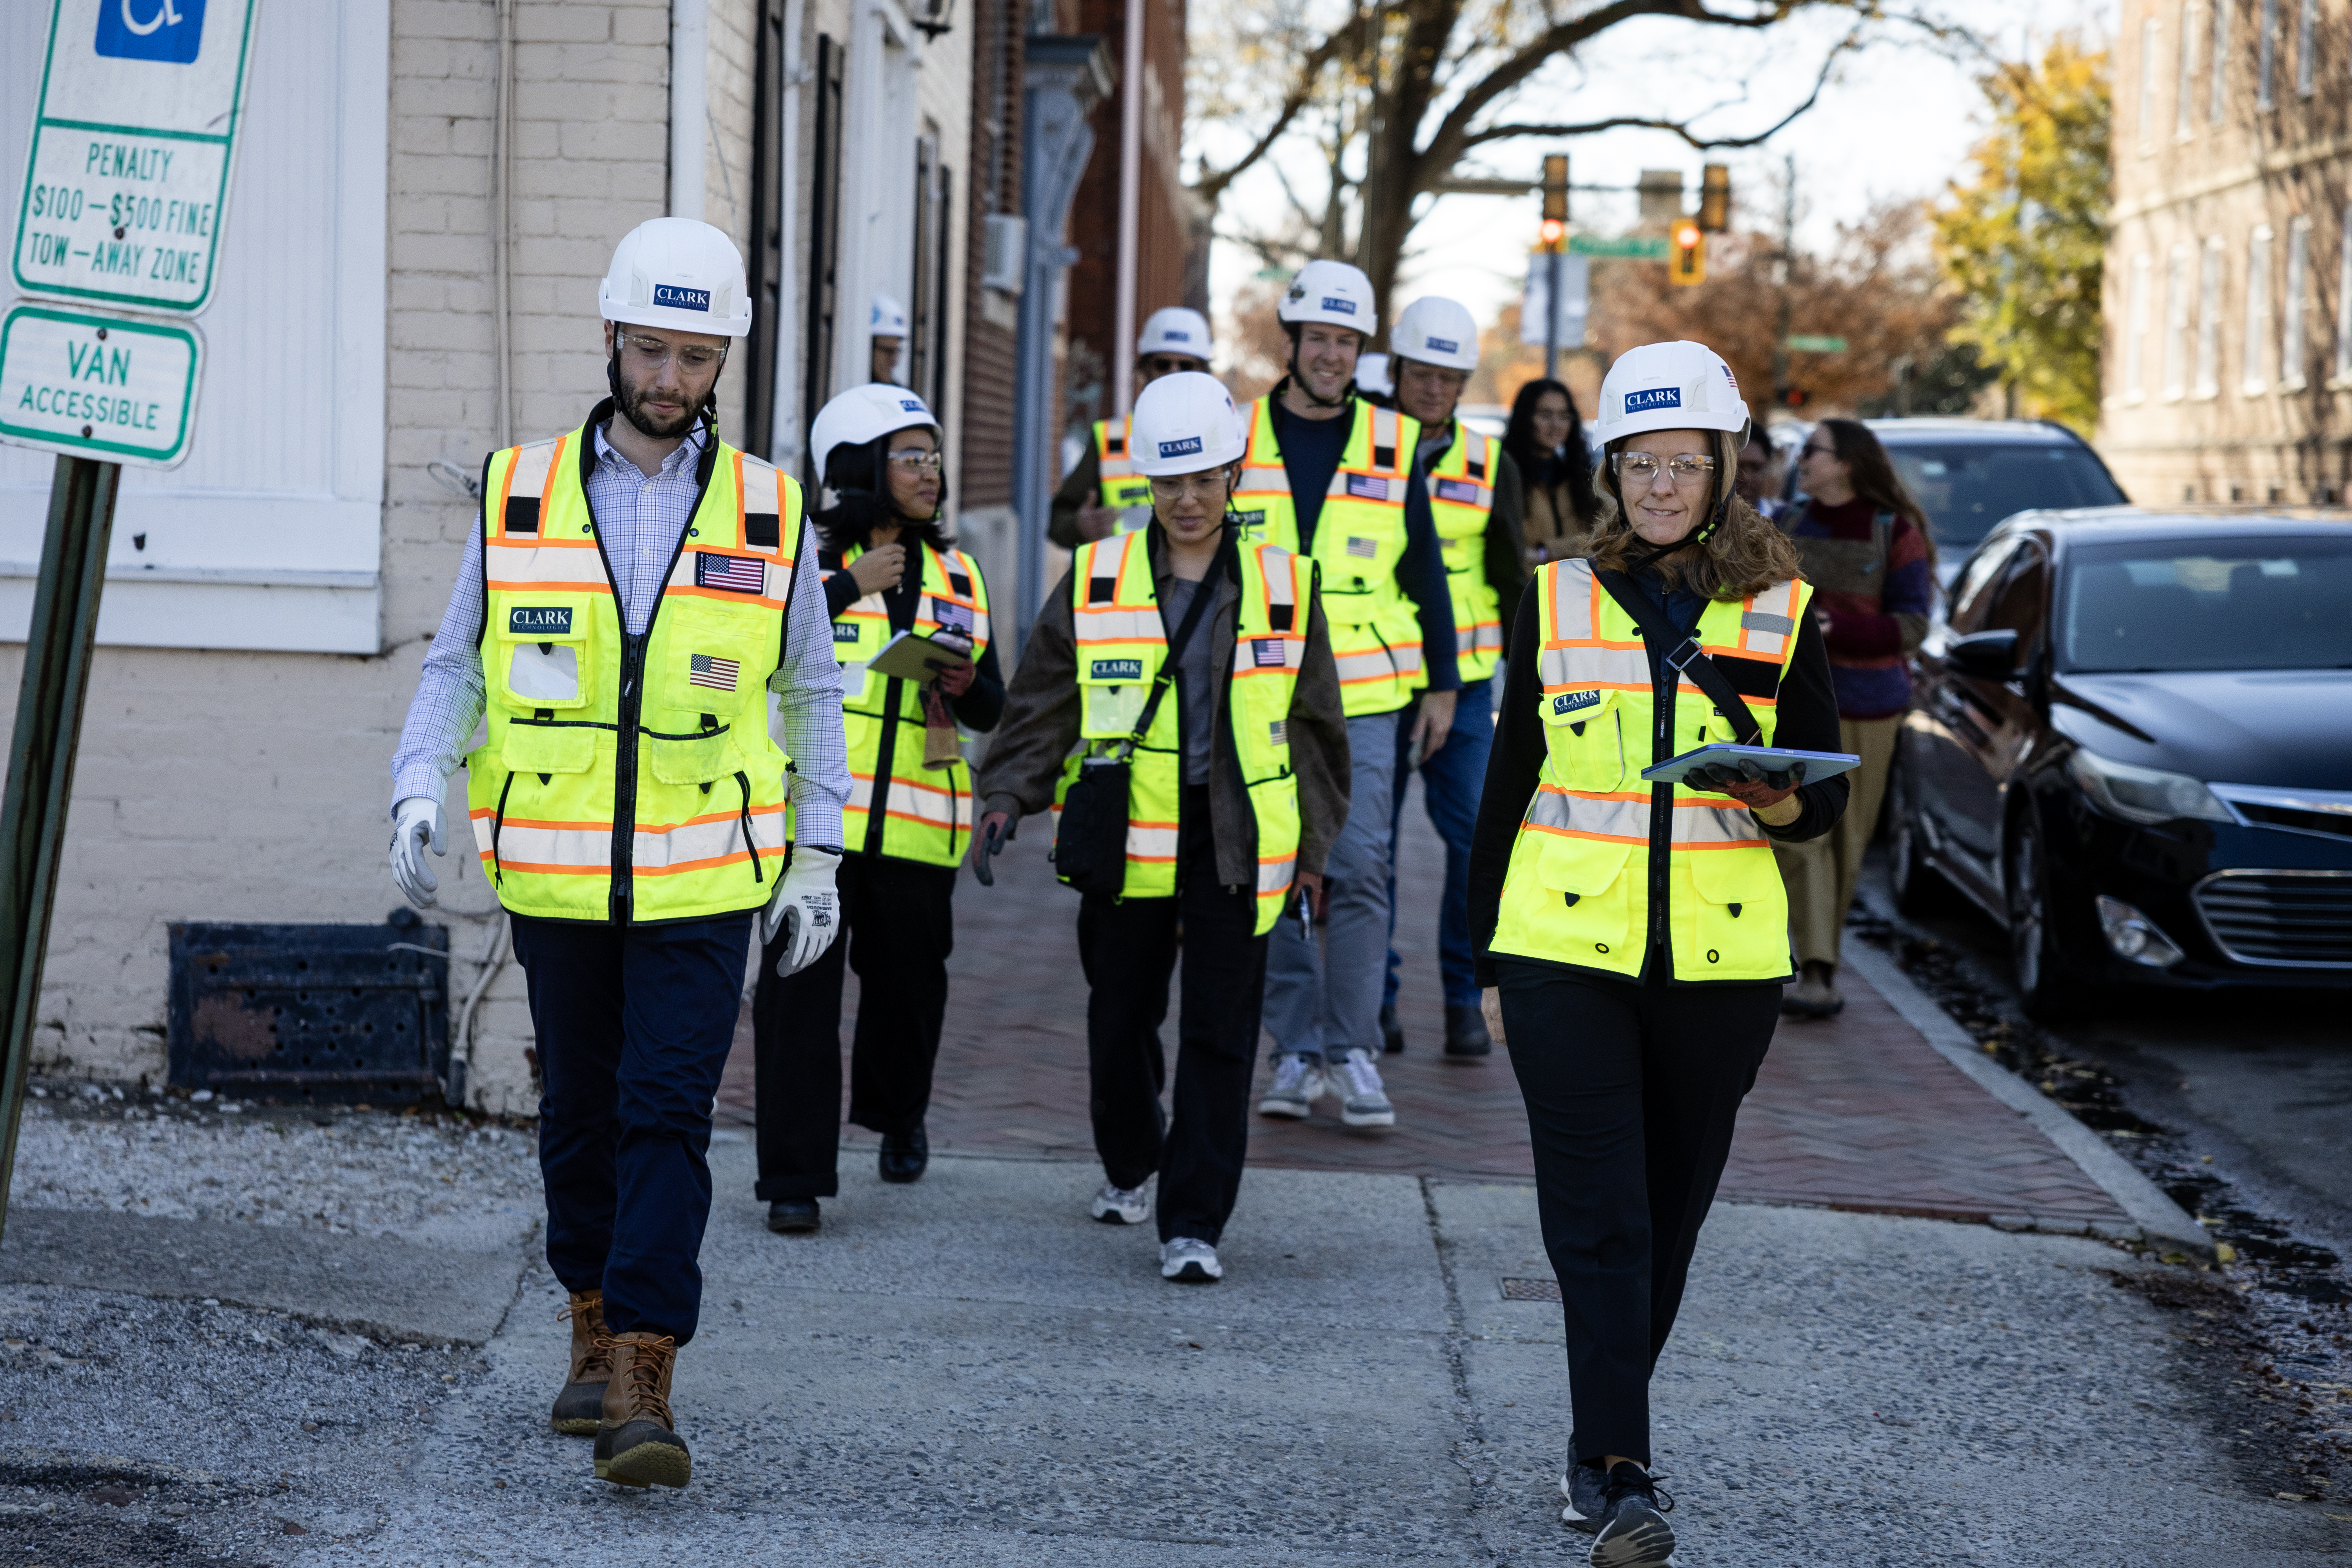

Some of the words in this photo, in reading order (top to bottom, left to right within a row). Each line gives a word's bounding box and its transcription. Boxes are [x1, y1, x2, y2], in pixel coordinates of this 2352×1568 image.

[85, 141, 174, 182] PENALTY
[165, 200, 212, 237] FINE
[150, 247, 201, 284] ZONE
[656, 298, 707, 309] CONSTRUCTION
[657, 288, 707, 304] CLARK
[68, 340, 131, 387] VAN
[1627, 390, 1678, 406] CLARK
[1628, 401, 1679, 411] CONSTRUCTION
[19, 385, 161, 430] ACCESSIBLE
[1160, 439, 1200, 453] CLARK
[513, 611, 569, 624] CLARK
[1093, 661, 1140, 673] CLARK
[1555, 690, 1598, 707] CLARK
[1556, 698, 1599, 712] CONSTRUCTION
